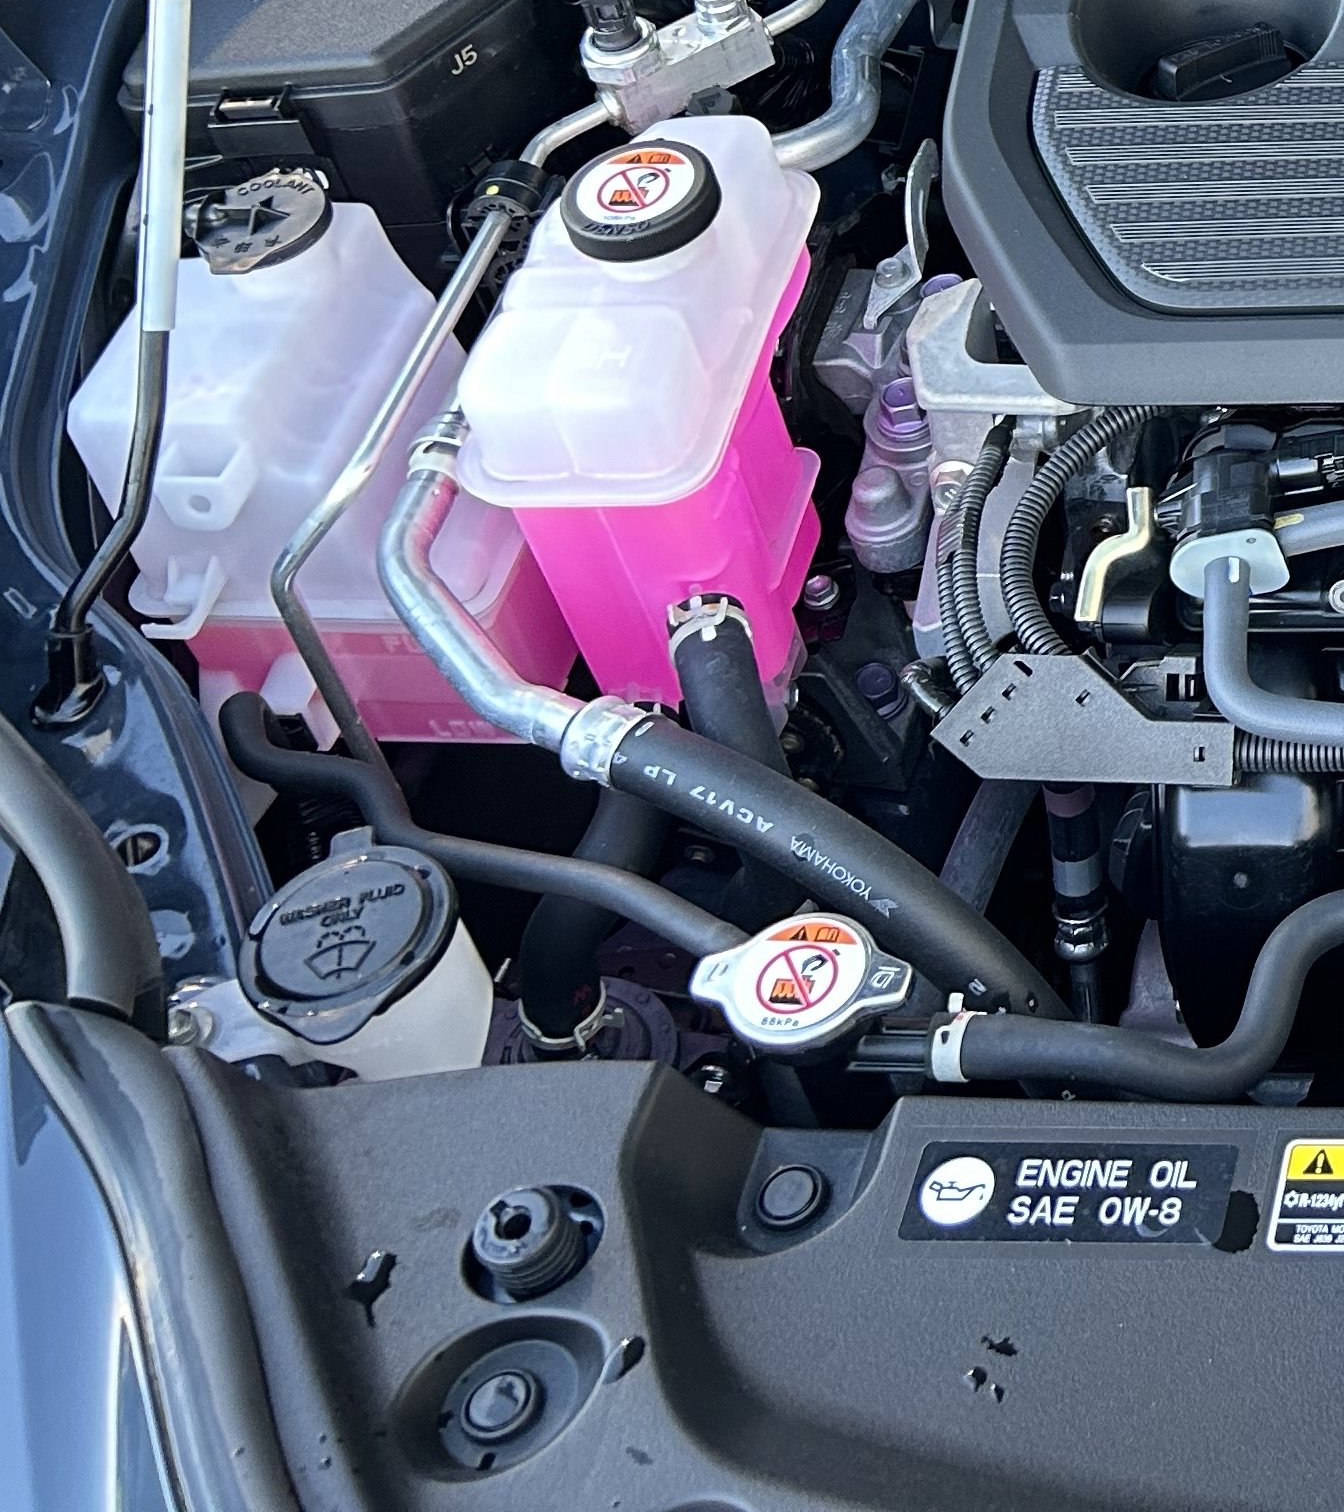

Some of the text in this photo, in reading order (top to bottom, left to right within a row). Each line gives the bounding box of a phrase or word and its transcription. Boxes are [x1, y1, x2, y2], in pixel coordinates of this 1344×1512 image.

[450, 44, 479, 76] J5
[643, 765, 677, 785] LP
[689, 785, 775, 833] ACV17
[790, 835, 873, 901] YOKOHAMA
[279, 883, 406, 926] WASHER FLUID
[320, 906, 365, 928] ONLY
[1016, 1158, 1198, 1190] ENGINE OIL
[1008, 1196, 1076, 1225] SAE
[1295, 1224, 1330, 1234] TOYOTA
